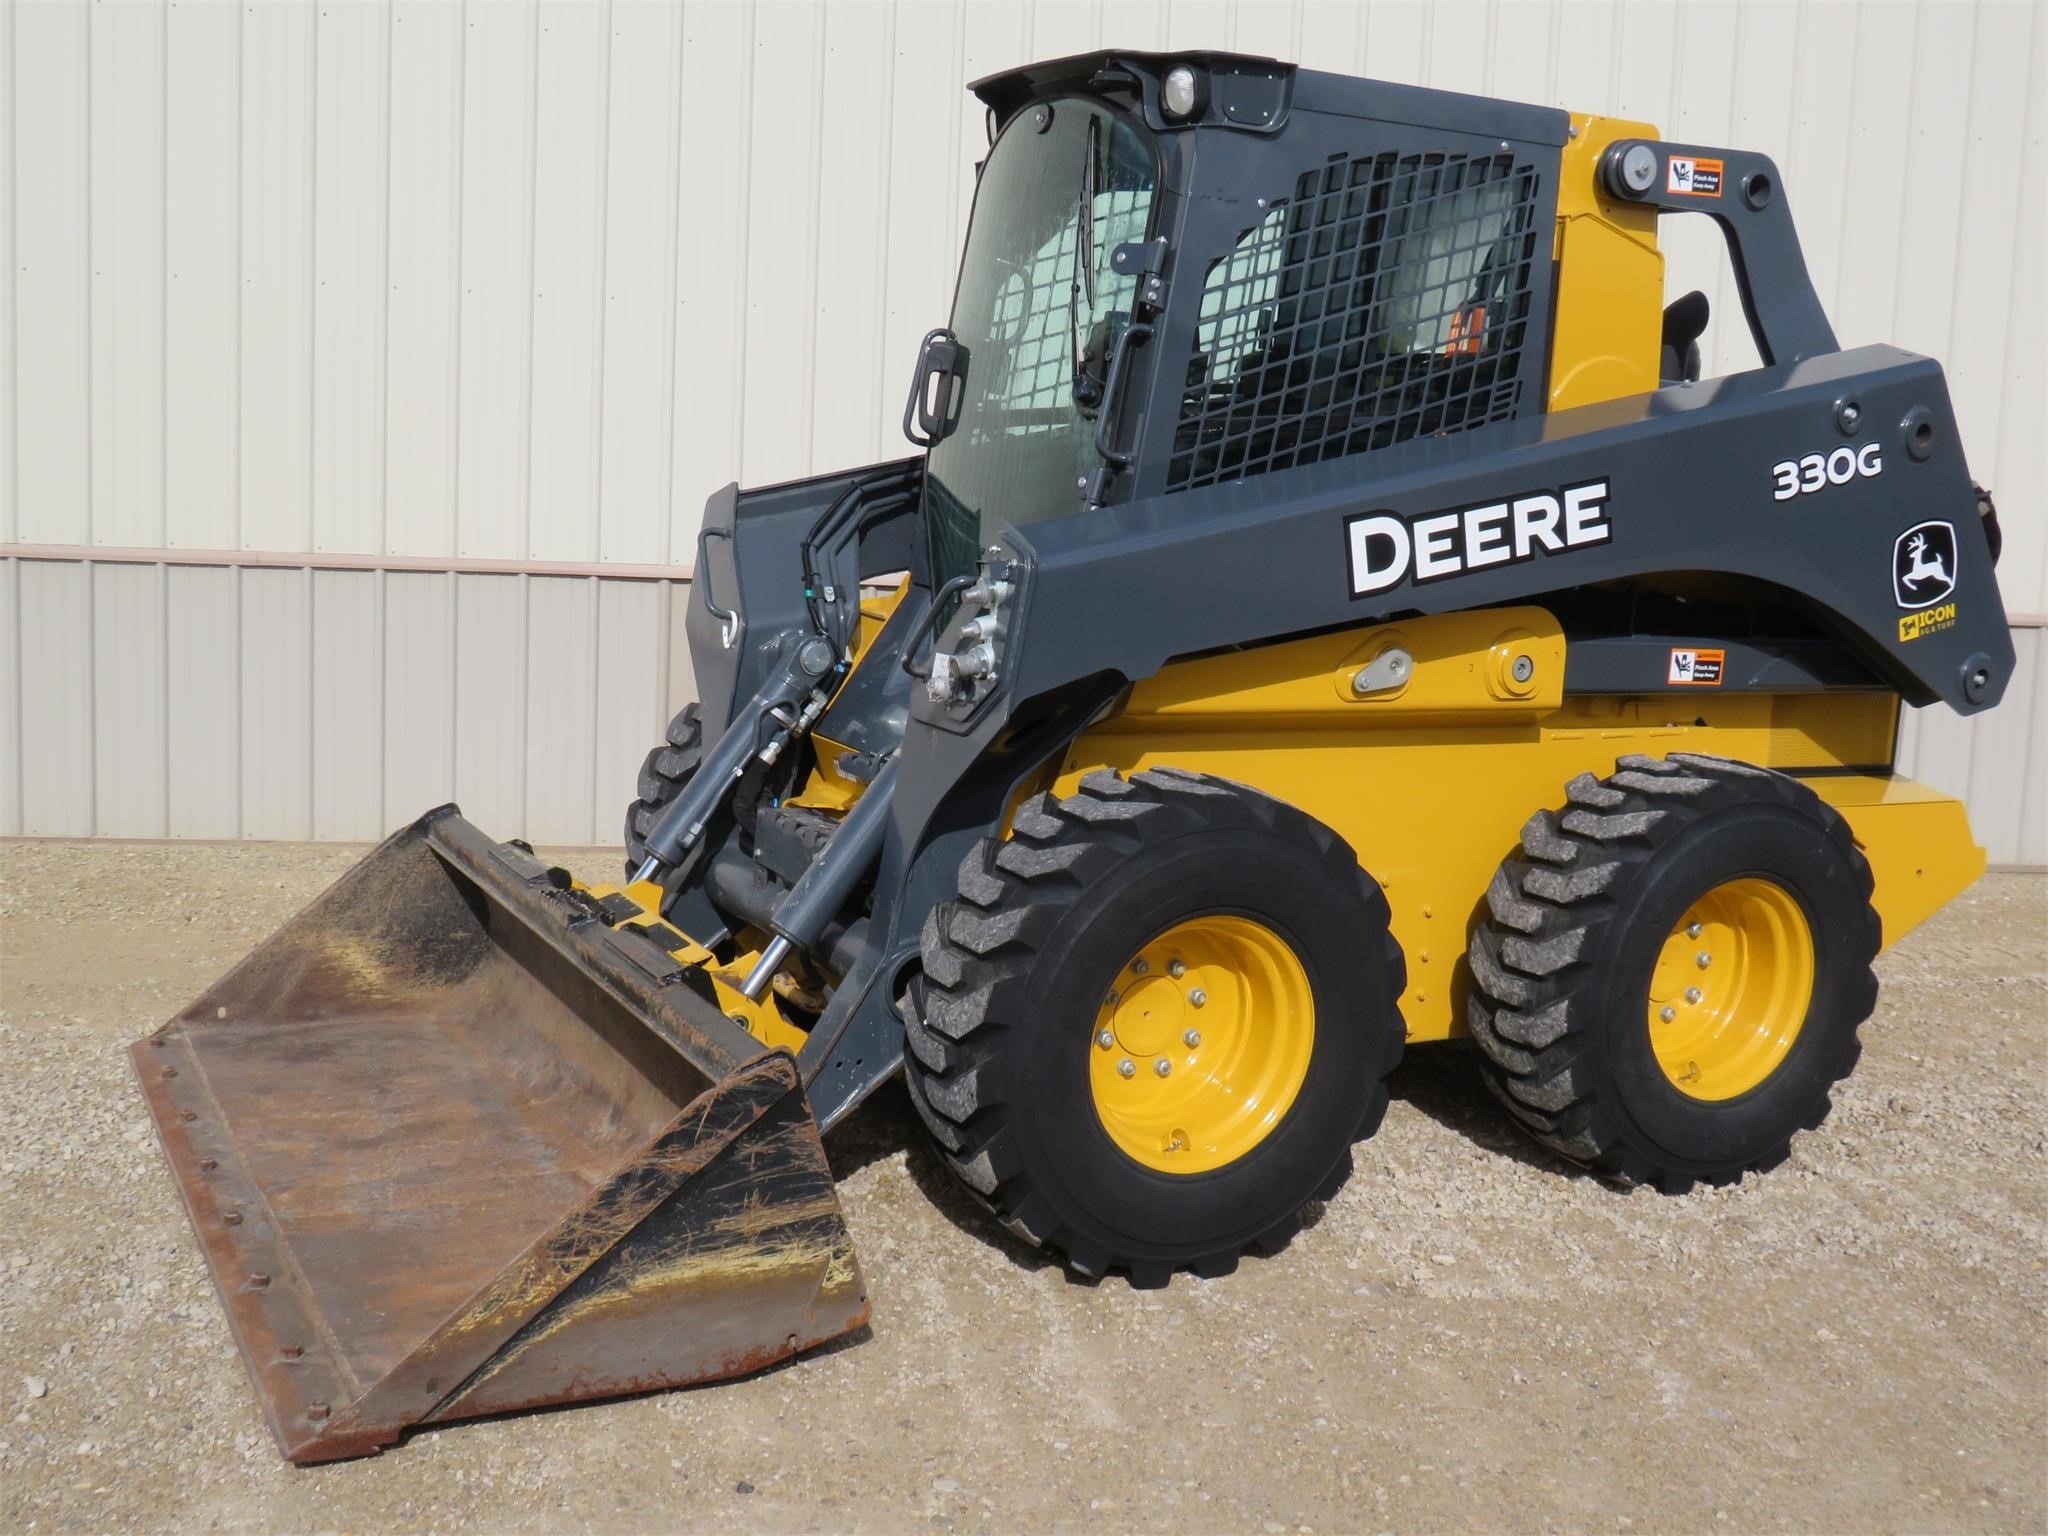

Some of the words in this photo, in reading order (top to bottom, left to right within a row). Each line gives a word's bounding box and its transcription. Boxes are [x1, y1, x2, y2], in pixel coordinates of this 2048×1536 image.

[1773, 442, 1882, 500] 330G
[1348, 482, 1609, 594] DEERE
[1919, 603, 1955, 627] ICON
